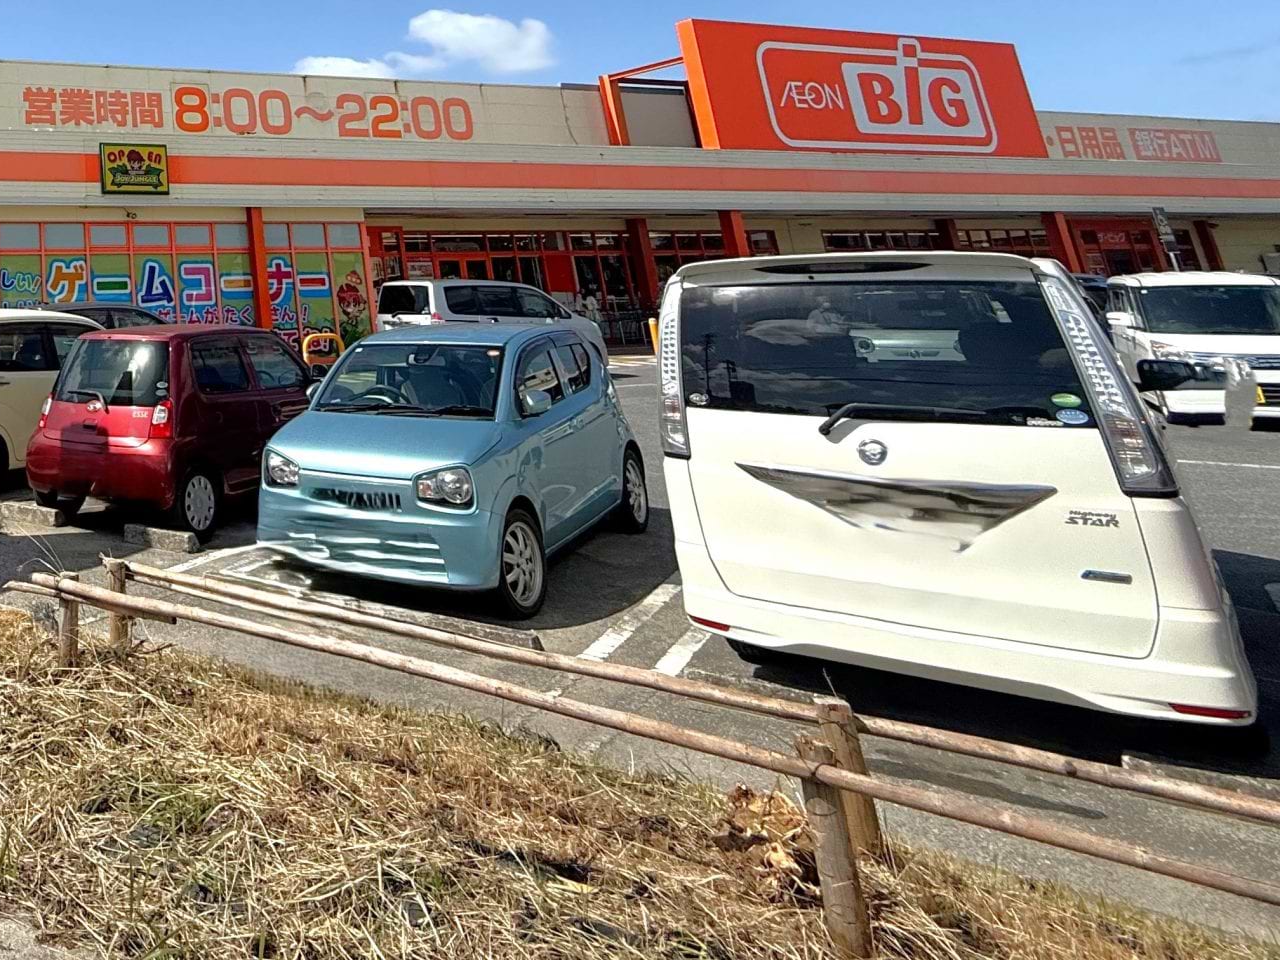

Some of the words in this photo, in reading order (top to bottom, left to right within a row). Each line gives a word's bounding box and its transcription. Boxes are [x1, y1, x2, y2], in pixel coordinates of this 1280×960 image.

[857, 43, 971, 127] BIG
[22, 86, 164, 128] 営業時間
[1064, 516, 1120, 528] STAR
[1069, 510, 1117, 521] Highway
